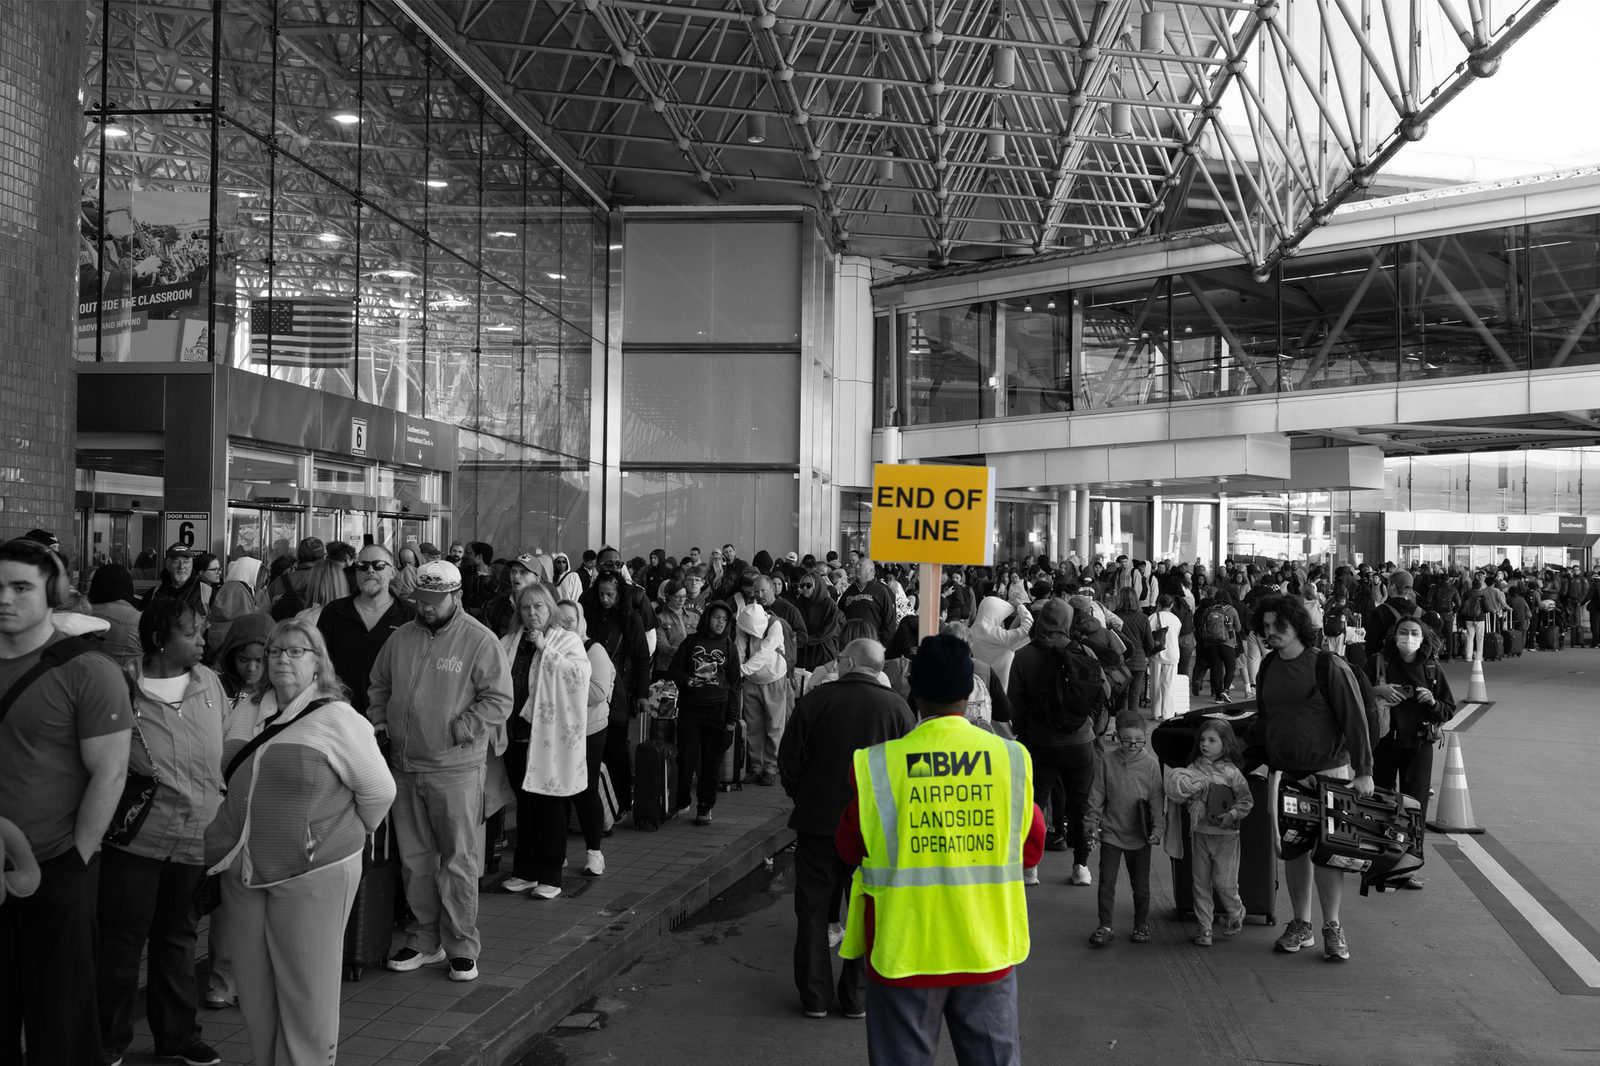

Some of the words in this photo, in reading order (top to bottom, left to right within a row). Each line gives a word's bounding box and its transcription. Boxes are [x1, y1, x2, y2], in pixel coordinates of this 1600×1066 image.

[120, 297, 137, 309] THE
[138, 289, 192, 305] CLASSROOM
[101, 321, 116, 330] AND
[357, 426, 362, 448] 6
[407, 425, 421, 433] Southwest
[877, 486, 935, 509] END
[944, 488, 983, 510] OF
[179, 521, 195, 548] 6
[896, 518, 960, 542] LINE
[436, 656, 463, 674] CAVS
[932, 751, 992, 777] BWI
[909, 784, 994, 804] AIRPORT
[909, 809, 995, 829] LANDSIDE
[910, 834, 995, 854] OPERATIONS
